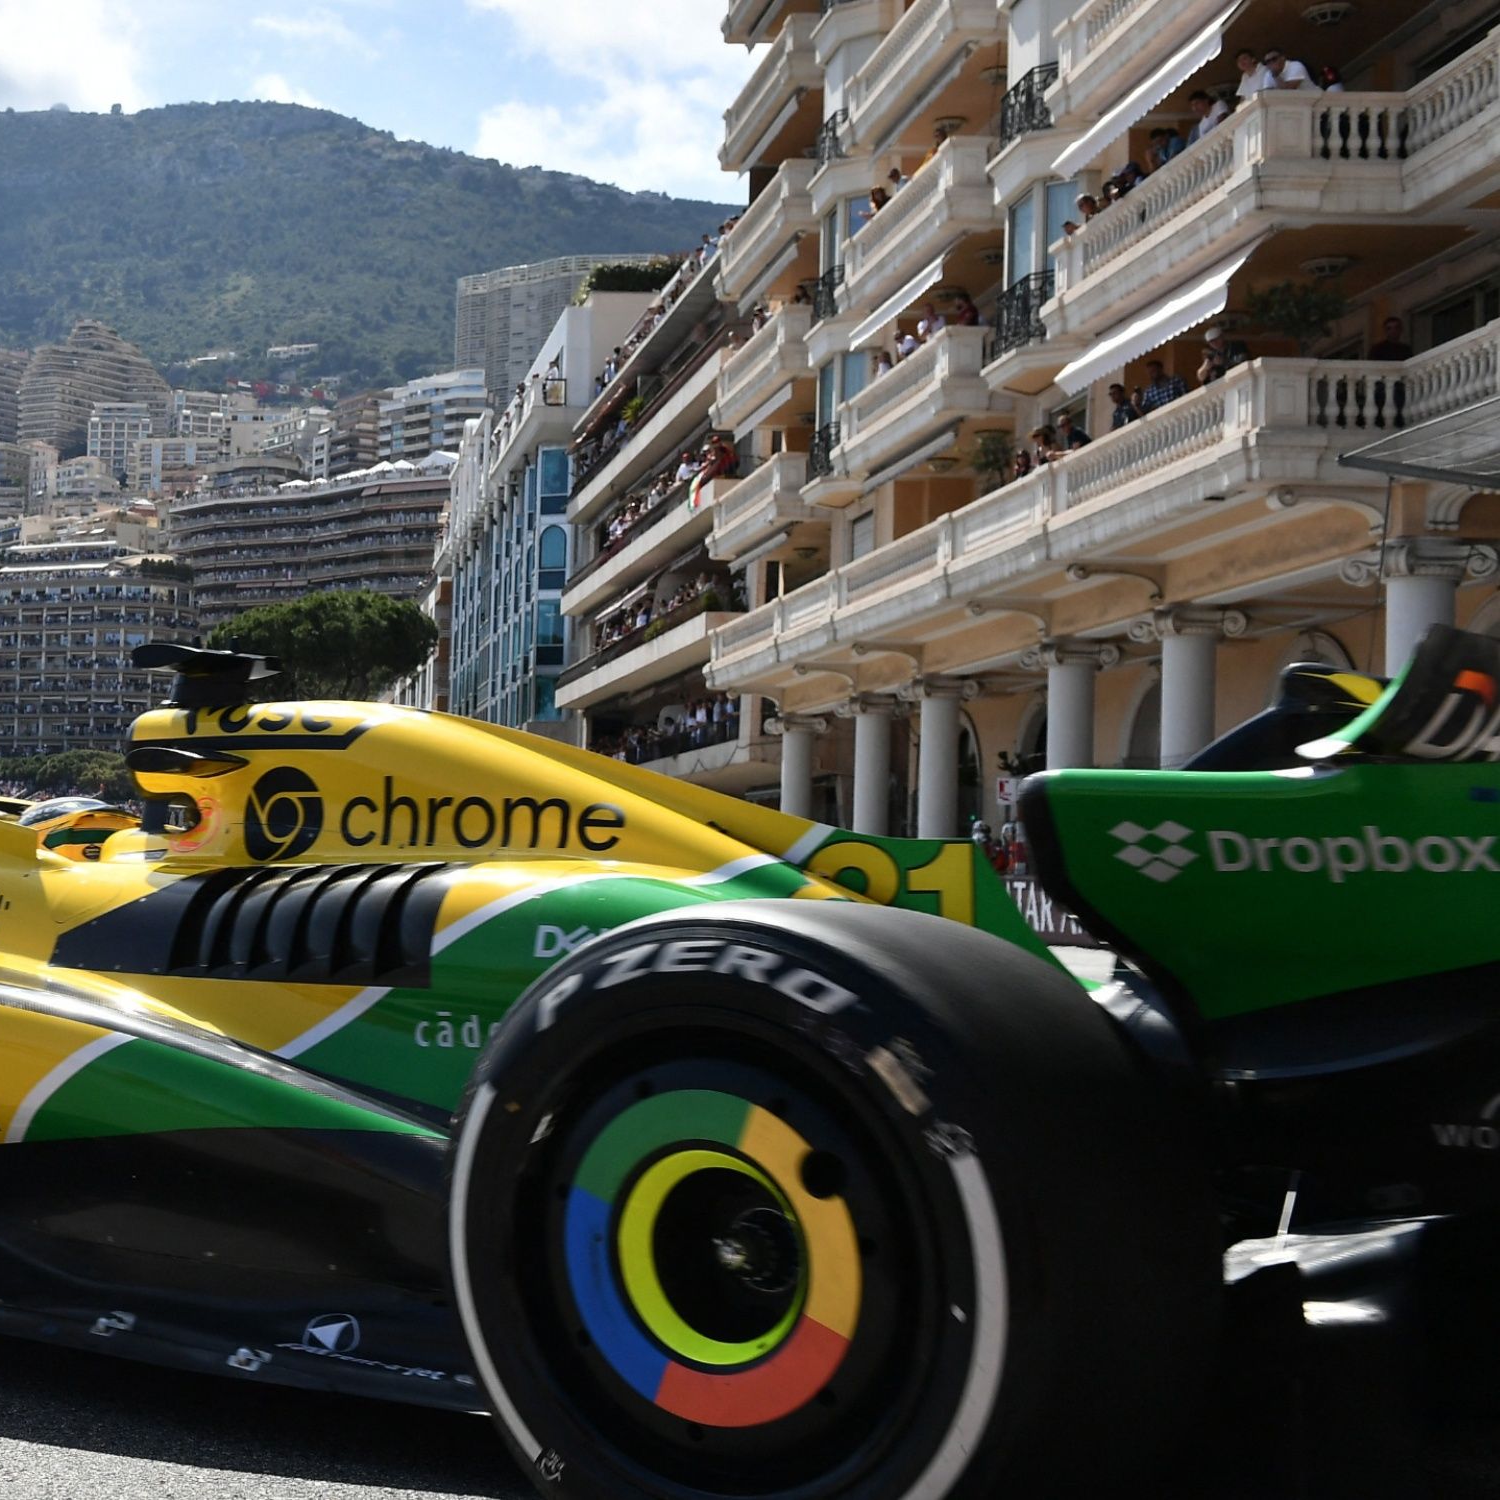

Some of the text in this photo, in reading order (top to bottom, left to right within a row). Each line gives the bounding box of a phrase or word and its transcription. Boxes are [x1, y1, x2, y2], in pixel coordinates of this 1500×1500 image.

[341, 776, 625, 851] chrome
[1205, 825, 1500, 883] Dropbox
[536, 940, 861, 1033] P ZERO
